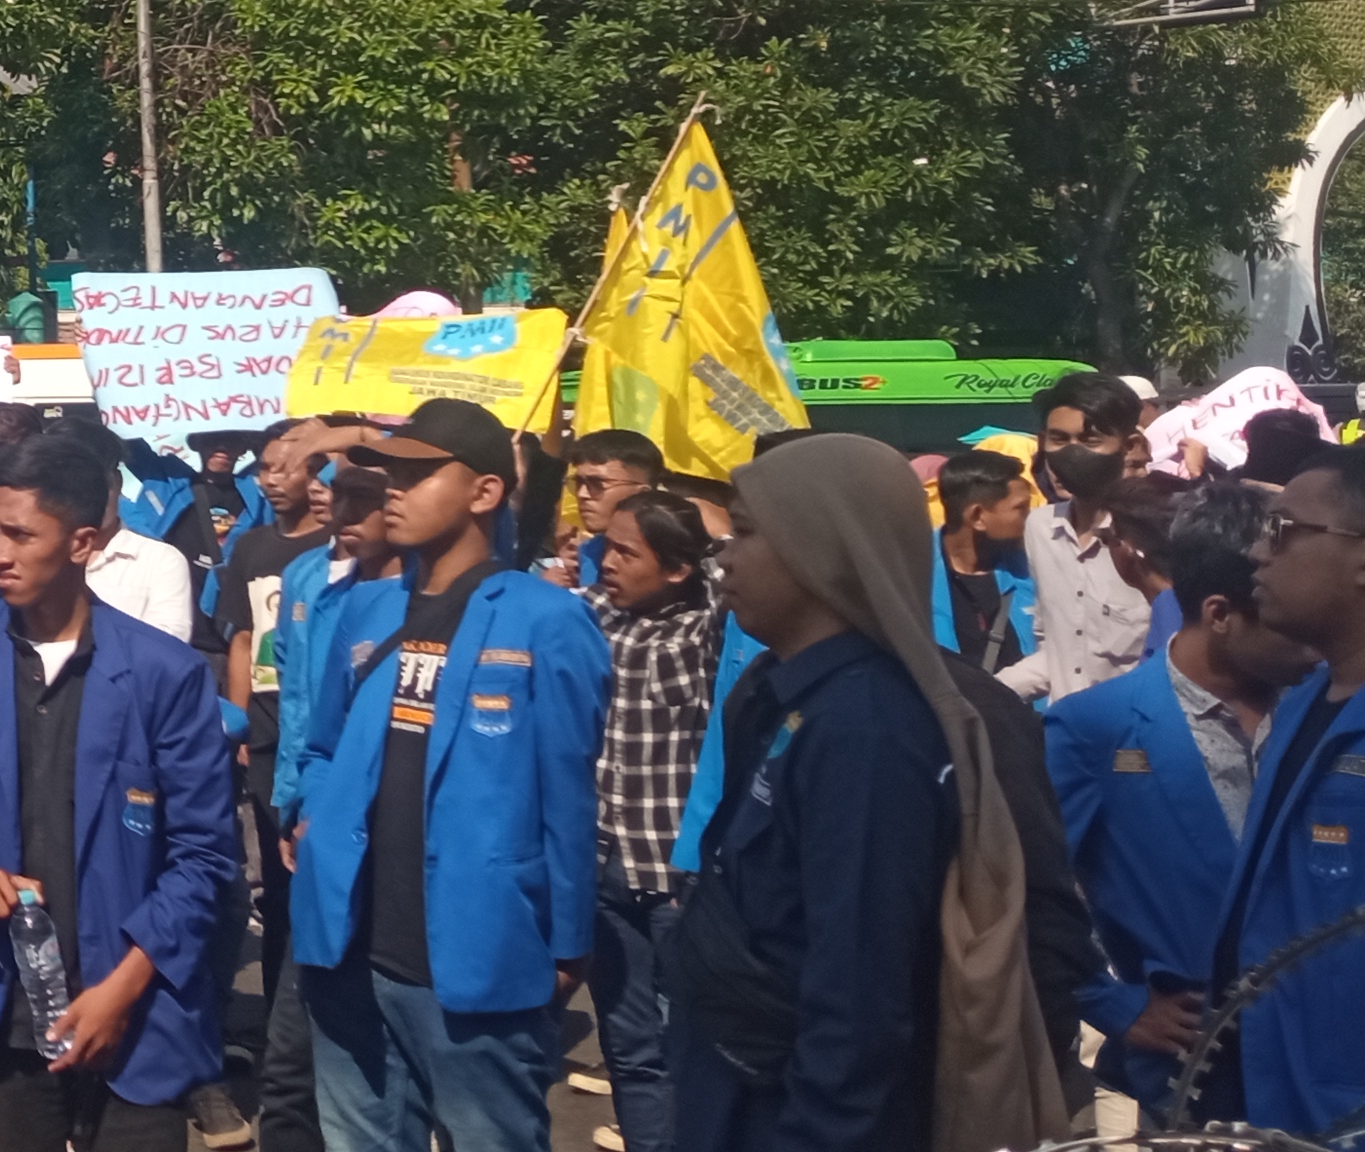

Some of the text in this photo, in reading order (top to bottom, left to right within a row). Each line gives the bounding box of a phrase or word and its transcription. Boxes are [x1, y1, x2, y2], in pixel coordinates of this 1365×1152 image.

[441, 316, 508, 341] PMII
[944, 372, 1058, 394] Royal Cla
